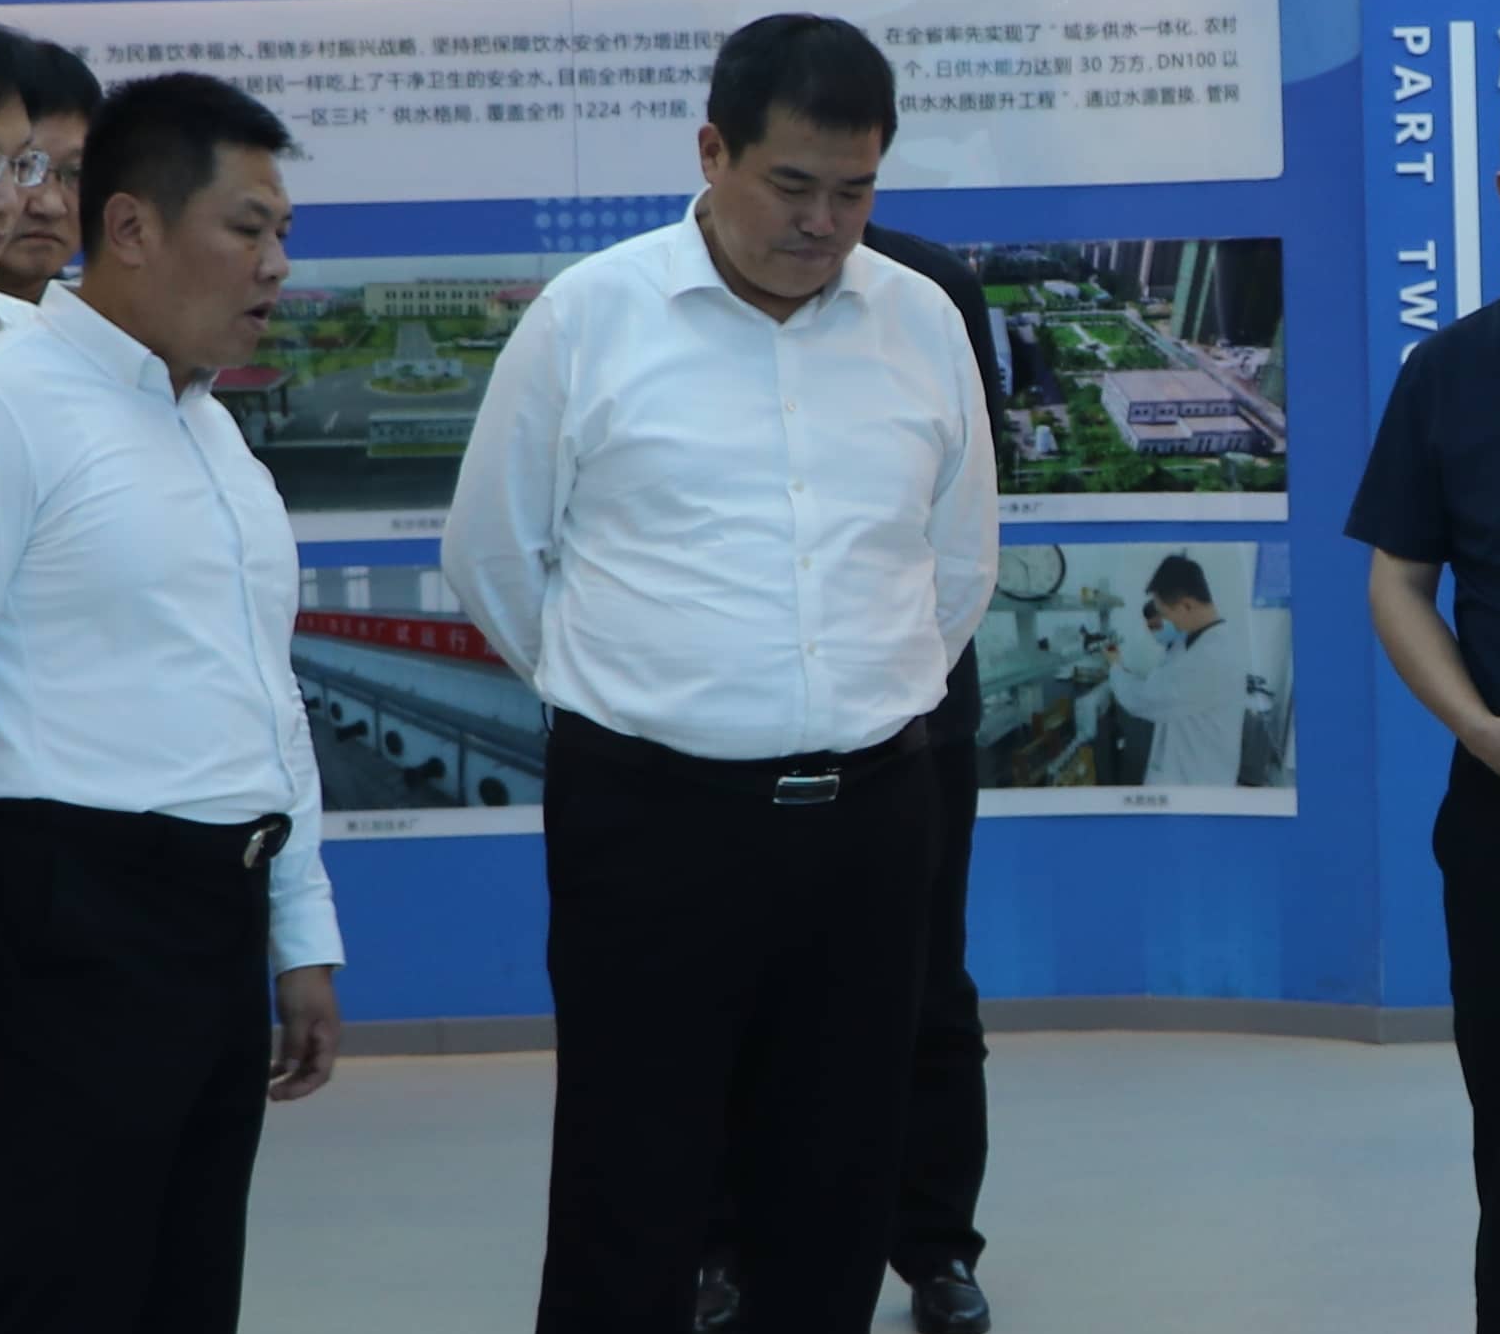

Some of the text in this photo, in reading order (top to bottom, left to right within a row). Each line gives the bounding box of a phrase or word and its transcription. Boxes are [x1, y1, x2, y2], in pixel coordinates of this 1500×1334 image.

[1080, 56, 1103, 74] 30
[576, 100, 622, 120] 1224
[1392, 25, 1435, 185] PART
